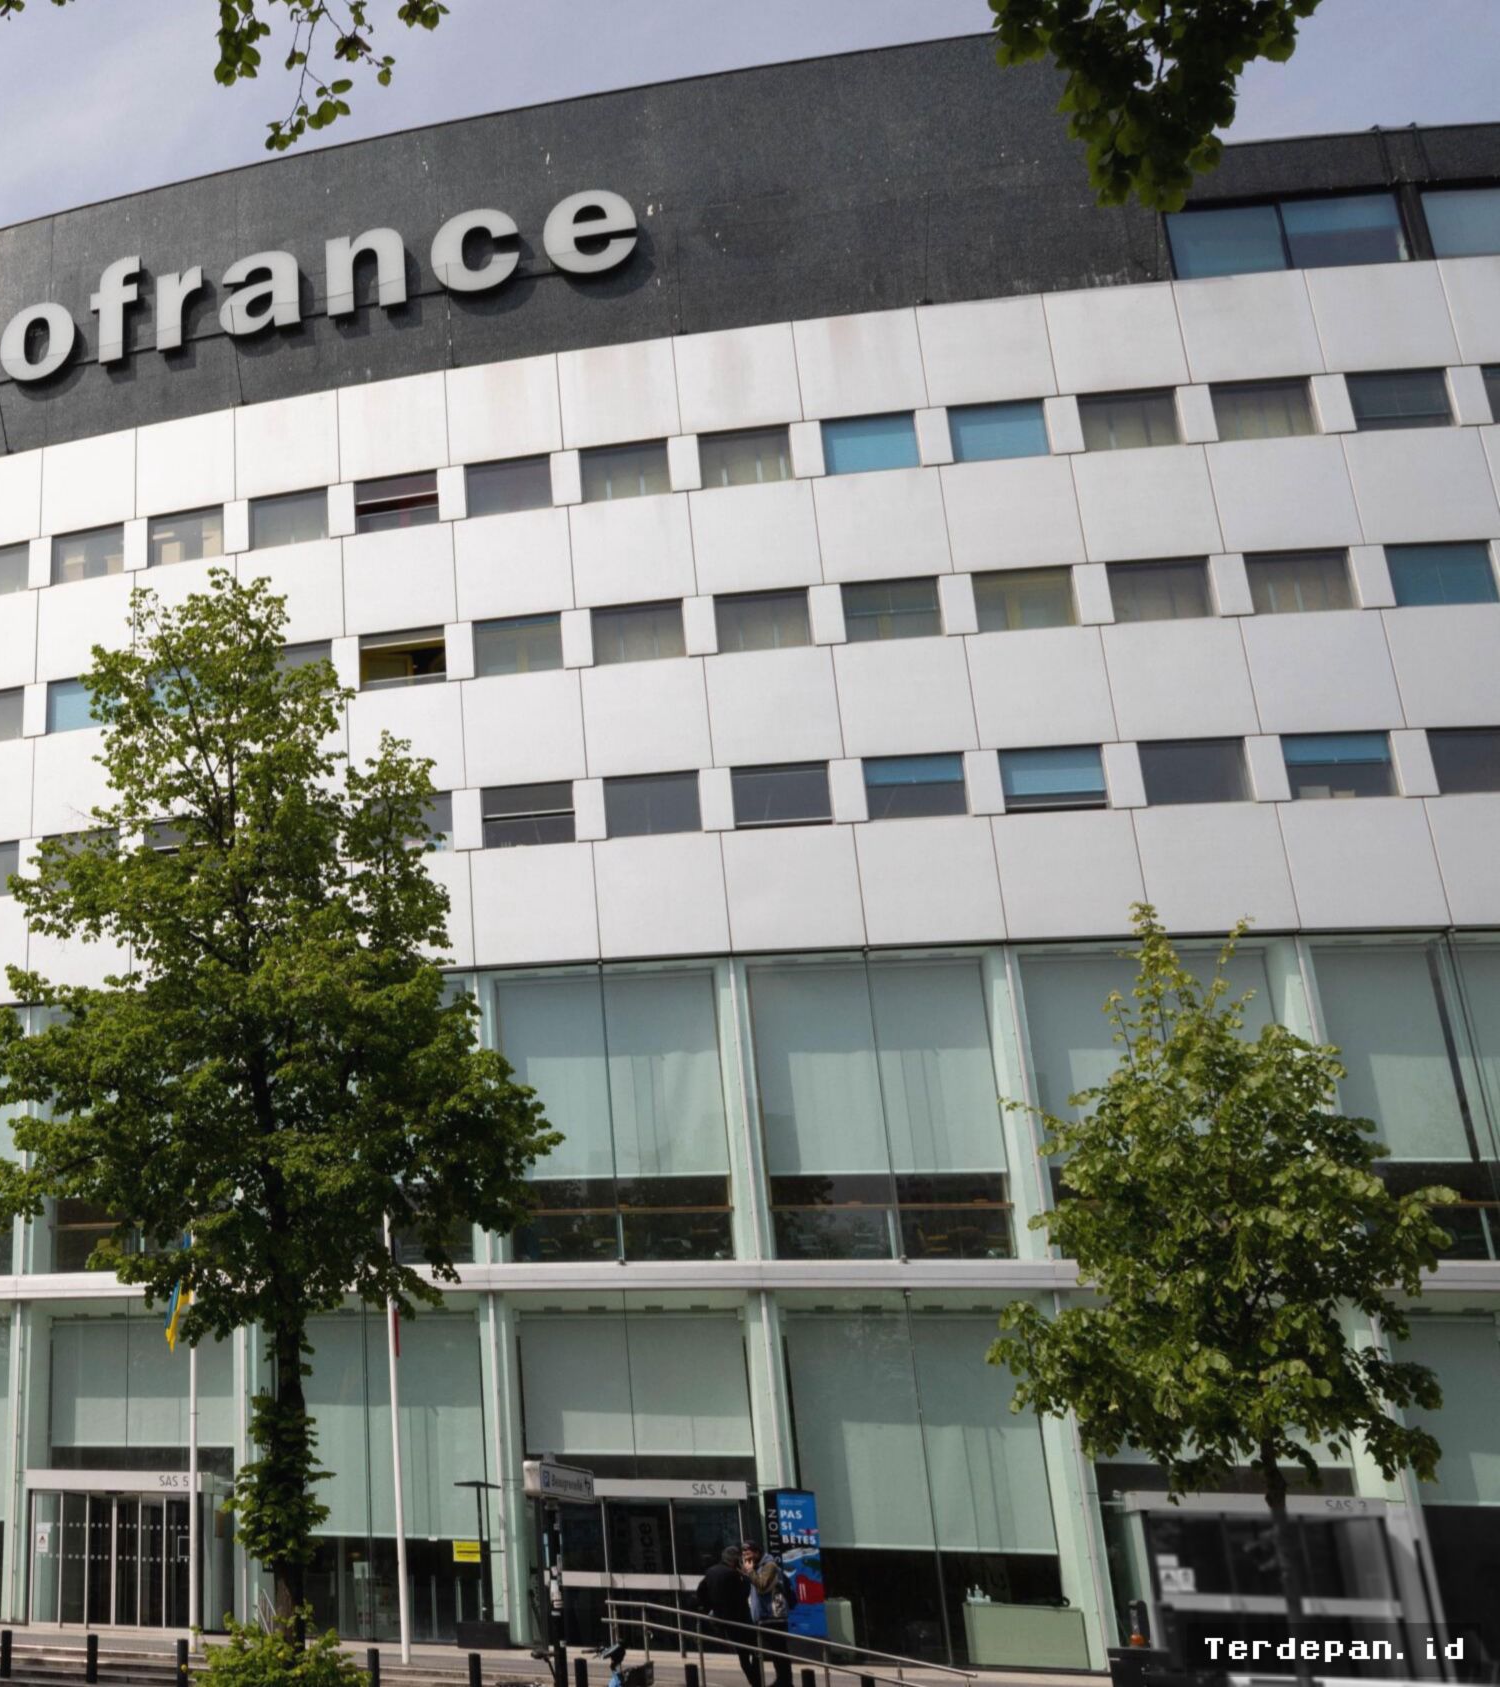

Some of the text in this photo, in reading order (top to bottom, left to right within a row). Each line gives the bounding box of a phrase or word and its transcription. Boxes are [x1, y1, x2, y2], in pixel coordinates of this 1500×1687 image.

[159, 1474, 189, 1487] SAS 5
[692, 1483, 728, 1496] SAS 4
[780, 1509, 803, 1519] PAS
[781, 1521, 792, 1531] SI
[782, 1531, 817, 1545] BÊTES
